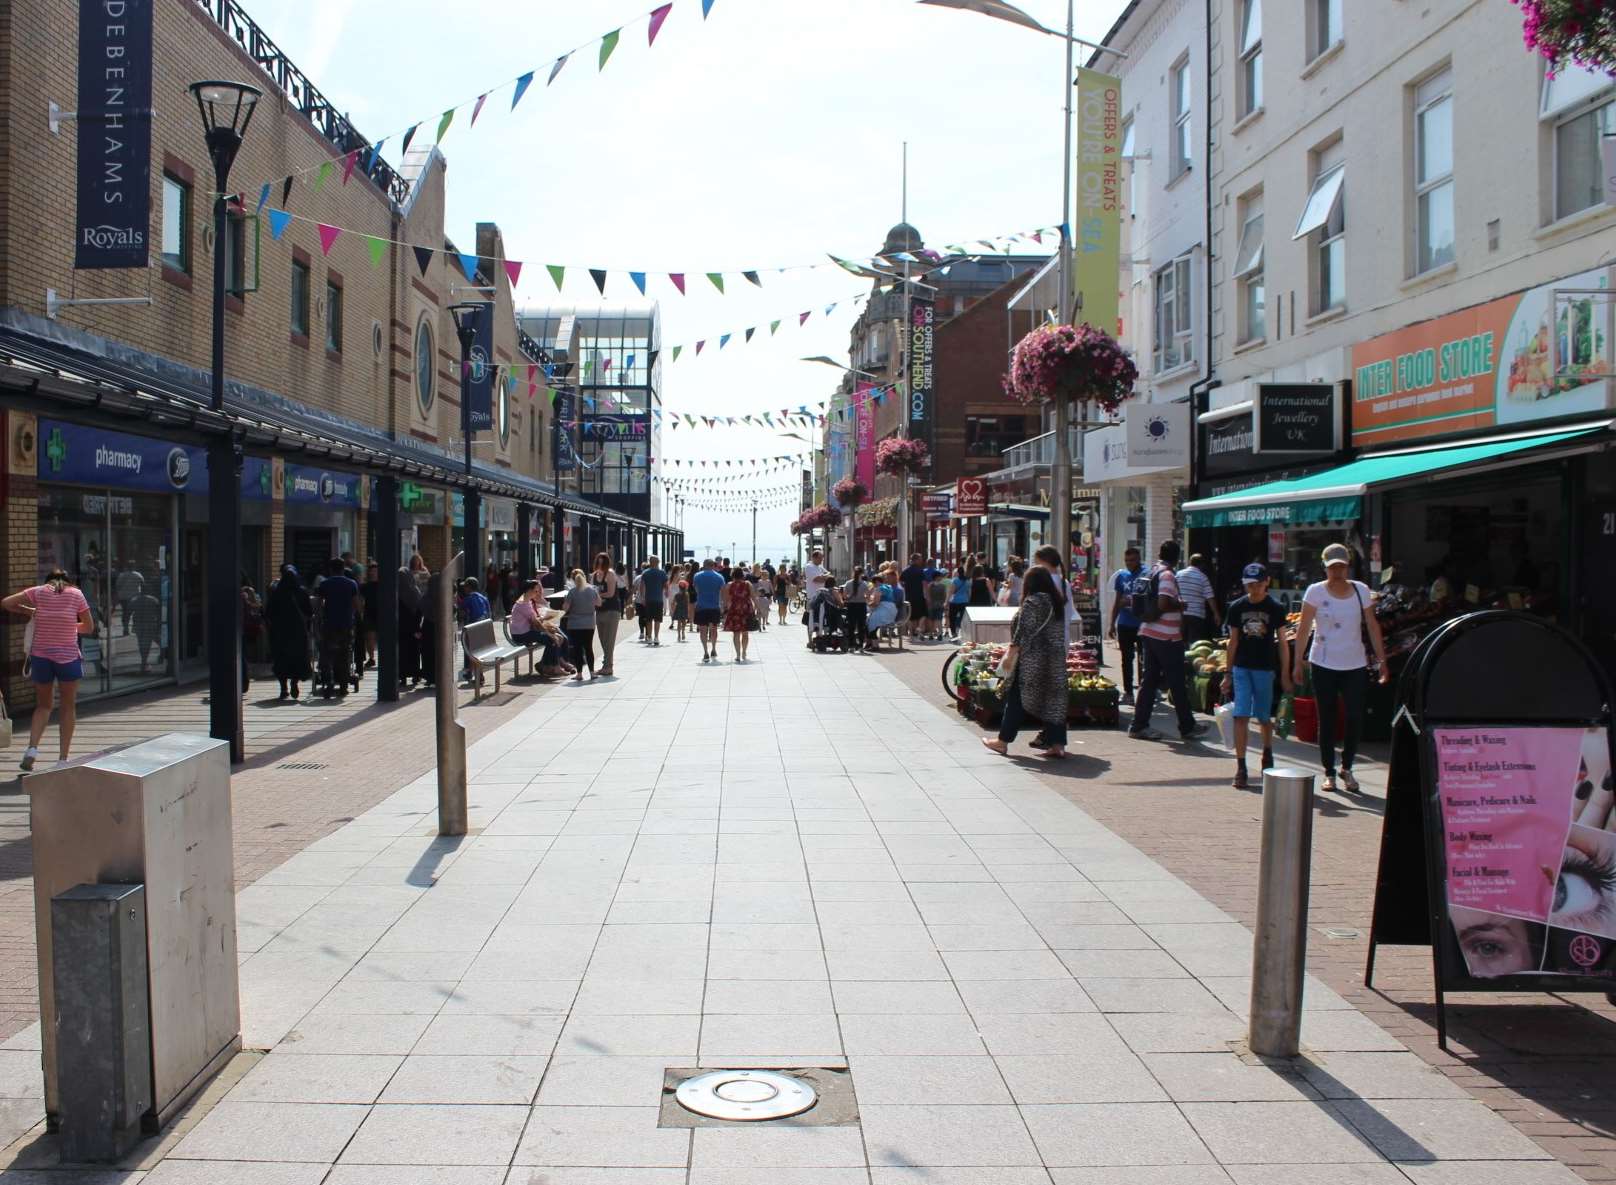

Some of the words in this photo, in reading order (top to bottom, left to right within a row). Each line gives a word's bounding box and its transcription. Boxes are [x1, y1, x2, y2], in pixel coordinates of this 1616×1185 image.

[105, 0, 125, 204] DEBENHAMS
[1103, 88, 1117, 140] OFFERS
[1103, 144, 1116, 155] &
[1103, 161, 1117, 212] TREATS
[83, 225, 144, 249] Royals
[924, 306, 934, 323] FOR
[924, 325, 934, 354] OFFERS
[923, 364, 934, 390] TREATS
[1356, 358, 1394, 402] INTER
[1396, 347, 1435, 394] FOOD
[1440, 331, 1494, 384] STORE
[1263, 394, 1332, 407] International
[1272, 411, 1320, 426] Jewellery
[1286, 429, 1307, 441] UK
[96, 445, 142, 473] pharmacy
[1247, 508, 1266, 521] FOOD
[1267, 506, 1291, 520] STORE
[1602, 512, 1615, 535] 21
[1474, 761, 1501, 773] Eyelash
